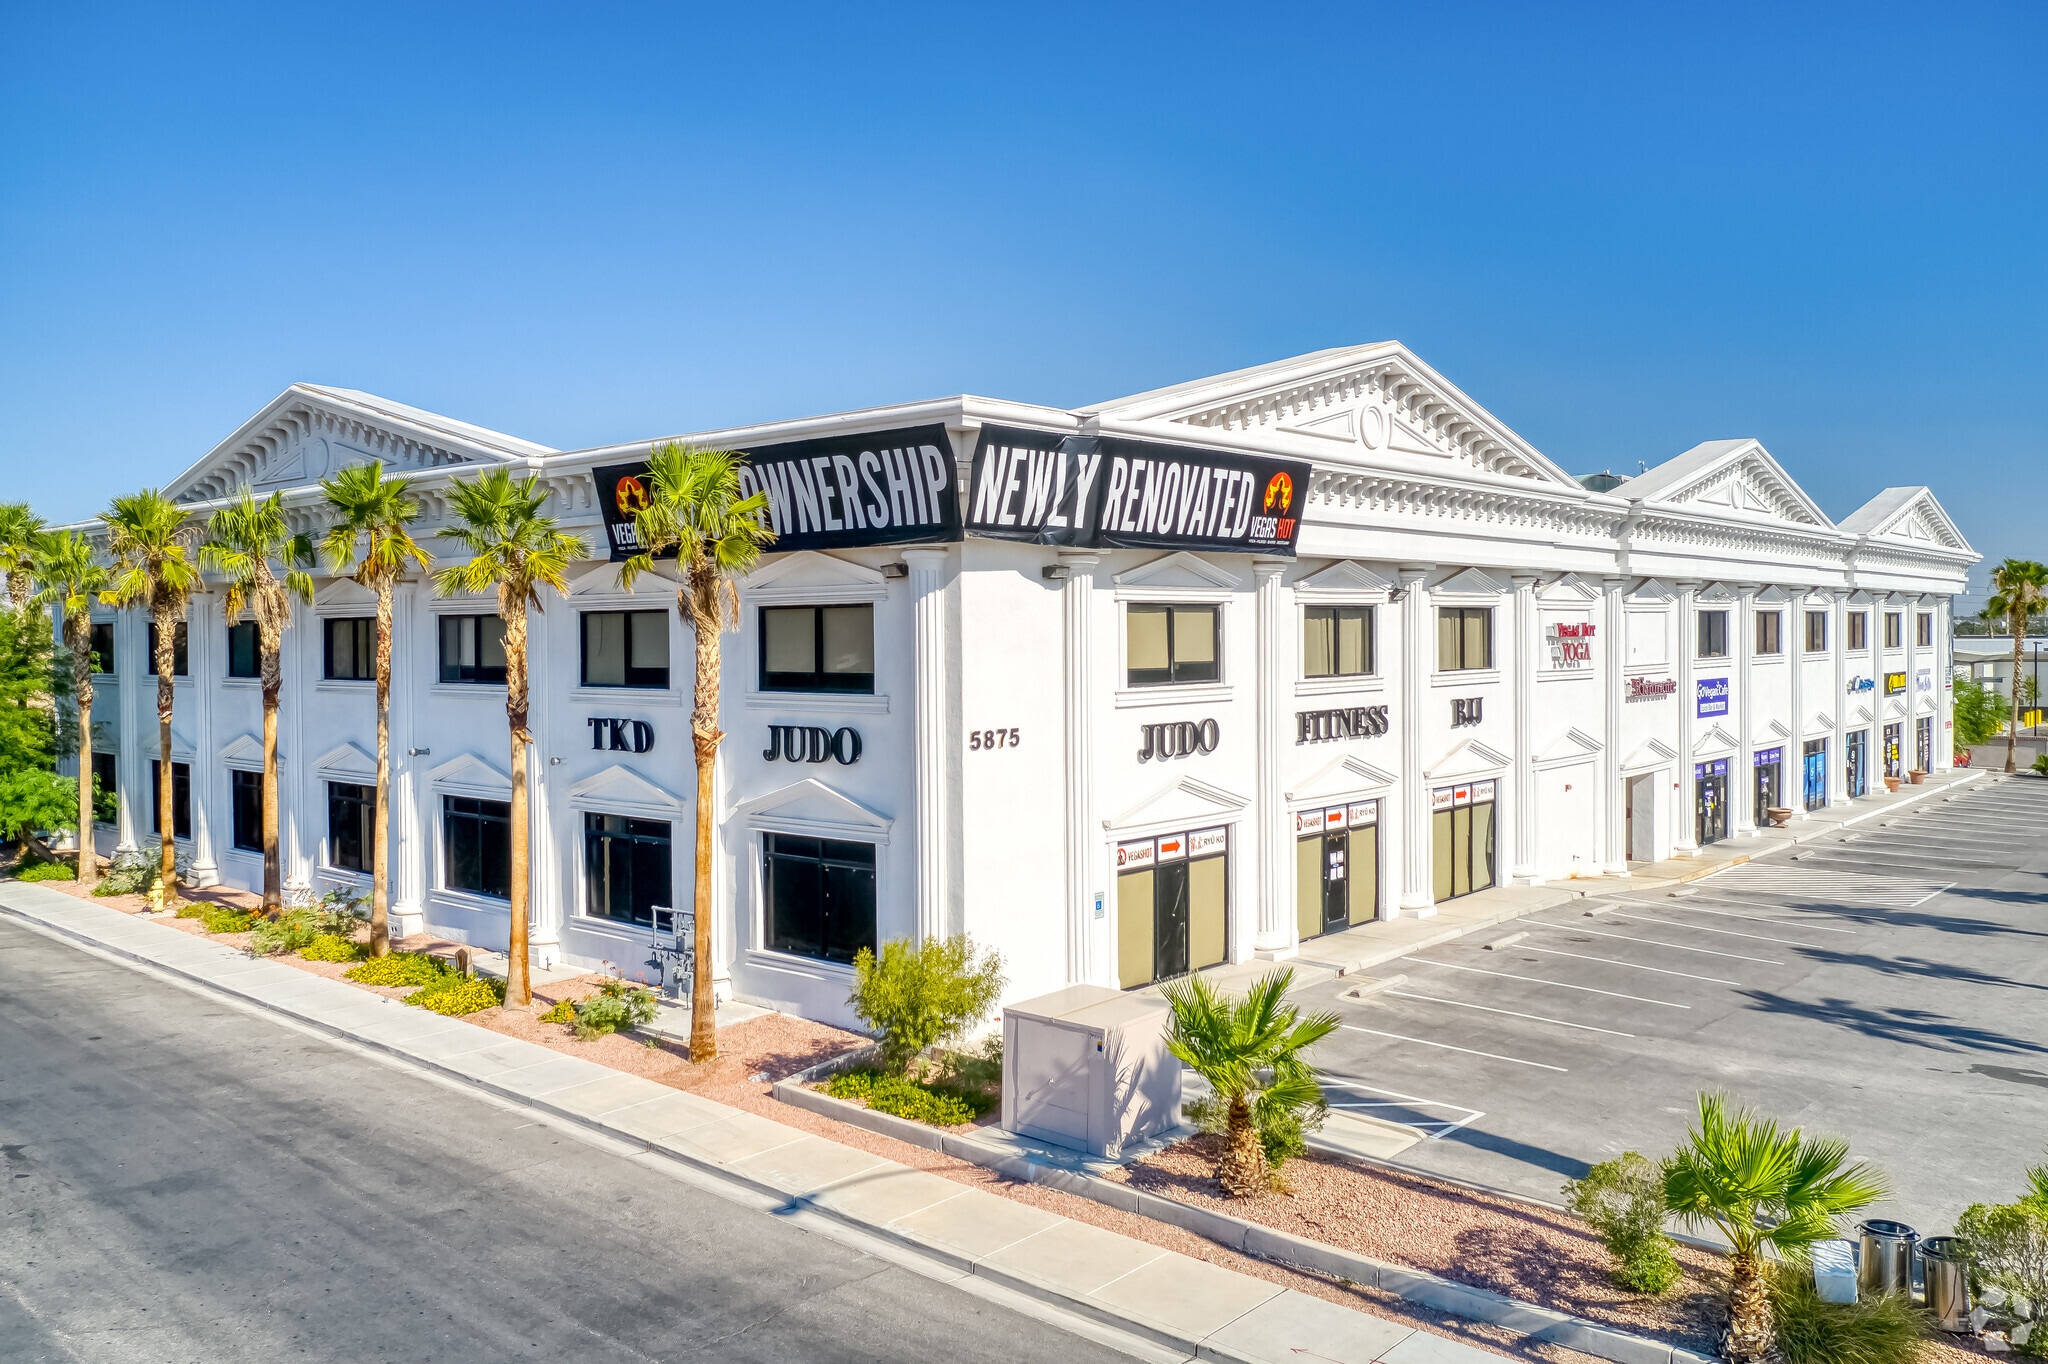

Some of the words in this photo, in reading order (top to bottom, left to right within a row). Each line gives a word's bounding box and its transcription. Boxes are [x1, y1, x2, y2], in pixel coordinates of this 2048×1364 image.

[738, 445, 948, 536] OWNERSHIP
[973, 444, 1102, 529] NEWLY
[1101, 456, 1255, 540] RENOVATED
[612, 522, 645, 545] VEGA
[1250, 516, 1278, 539] VEGAS
[1277, 518, 1296, 540] HOT
[1562, 642, 1591, 661] YOGA
[588, 717, 656, 754] TKD
[969, 727, 1021, 751] 5875
[1138, 718, 1220, 763] JUDO
[1295, 705, 1389, 745] FITNESS
[763, 724, 863, 766] JUDO
[1216, 834, 1225, 843] KO
